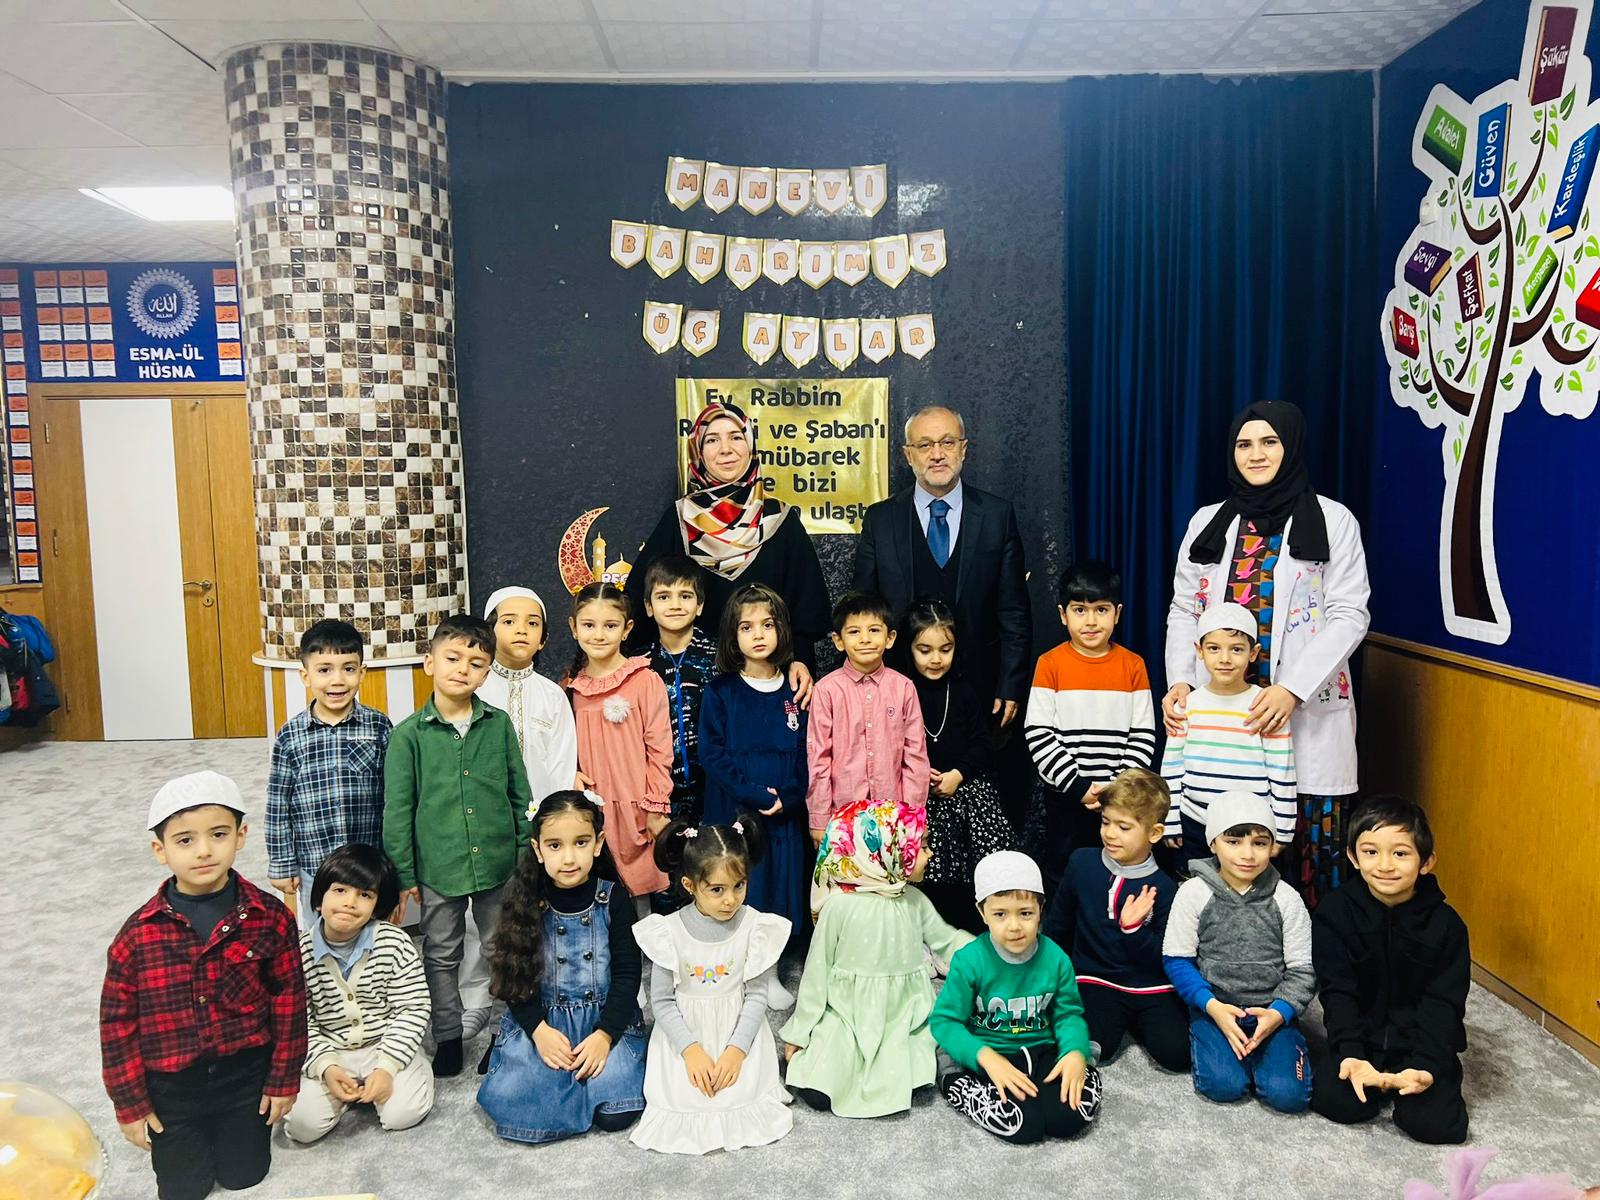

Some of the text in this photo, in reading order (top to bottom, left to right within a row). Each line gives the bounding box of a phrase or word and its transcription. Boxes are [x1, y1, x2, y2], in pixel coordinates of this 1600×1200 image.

[1434, 117, 1459, 150] Adalet
[1479, 120, 1500, 187] Güven
[677, 173, 874, 200] MANEVİ
[622, 234, 937, 273] BAHARIMIZ
[1414, 247, 1438, 273] Sevgi
[1462, 270, 1480, 317] Şefkat
[653, 312, 926, 351] ÜÇ AYLAR
[129, 345, 204, 361] ESMA-ÜL
[139, 363, 196, 379] HÜSNA
[751, 386, 842, 407] Rabbim
[769, 424, 797, 439] ve
[806, 418, 886, 443] Şaban'ı
[757, 446, 861, 467] mübarek
[793, 471, 837, 493] bizi
[810, 502, 867, 524] ulaşt
